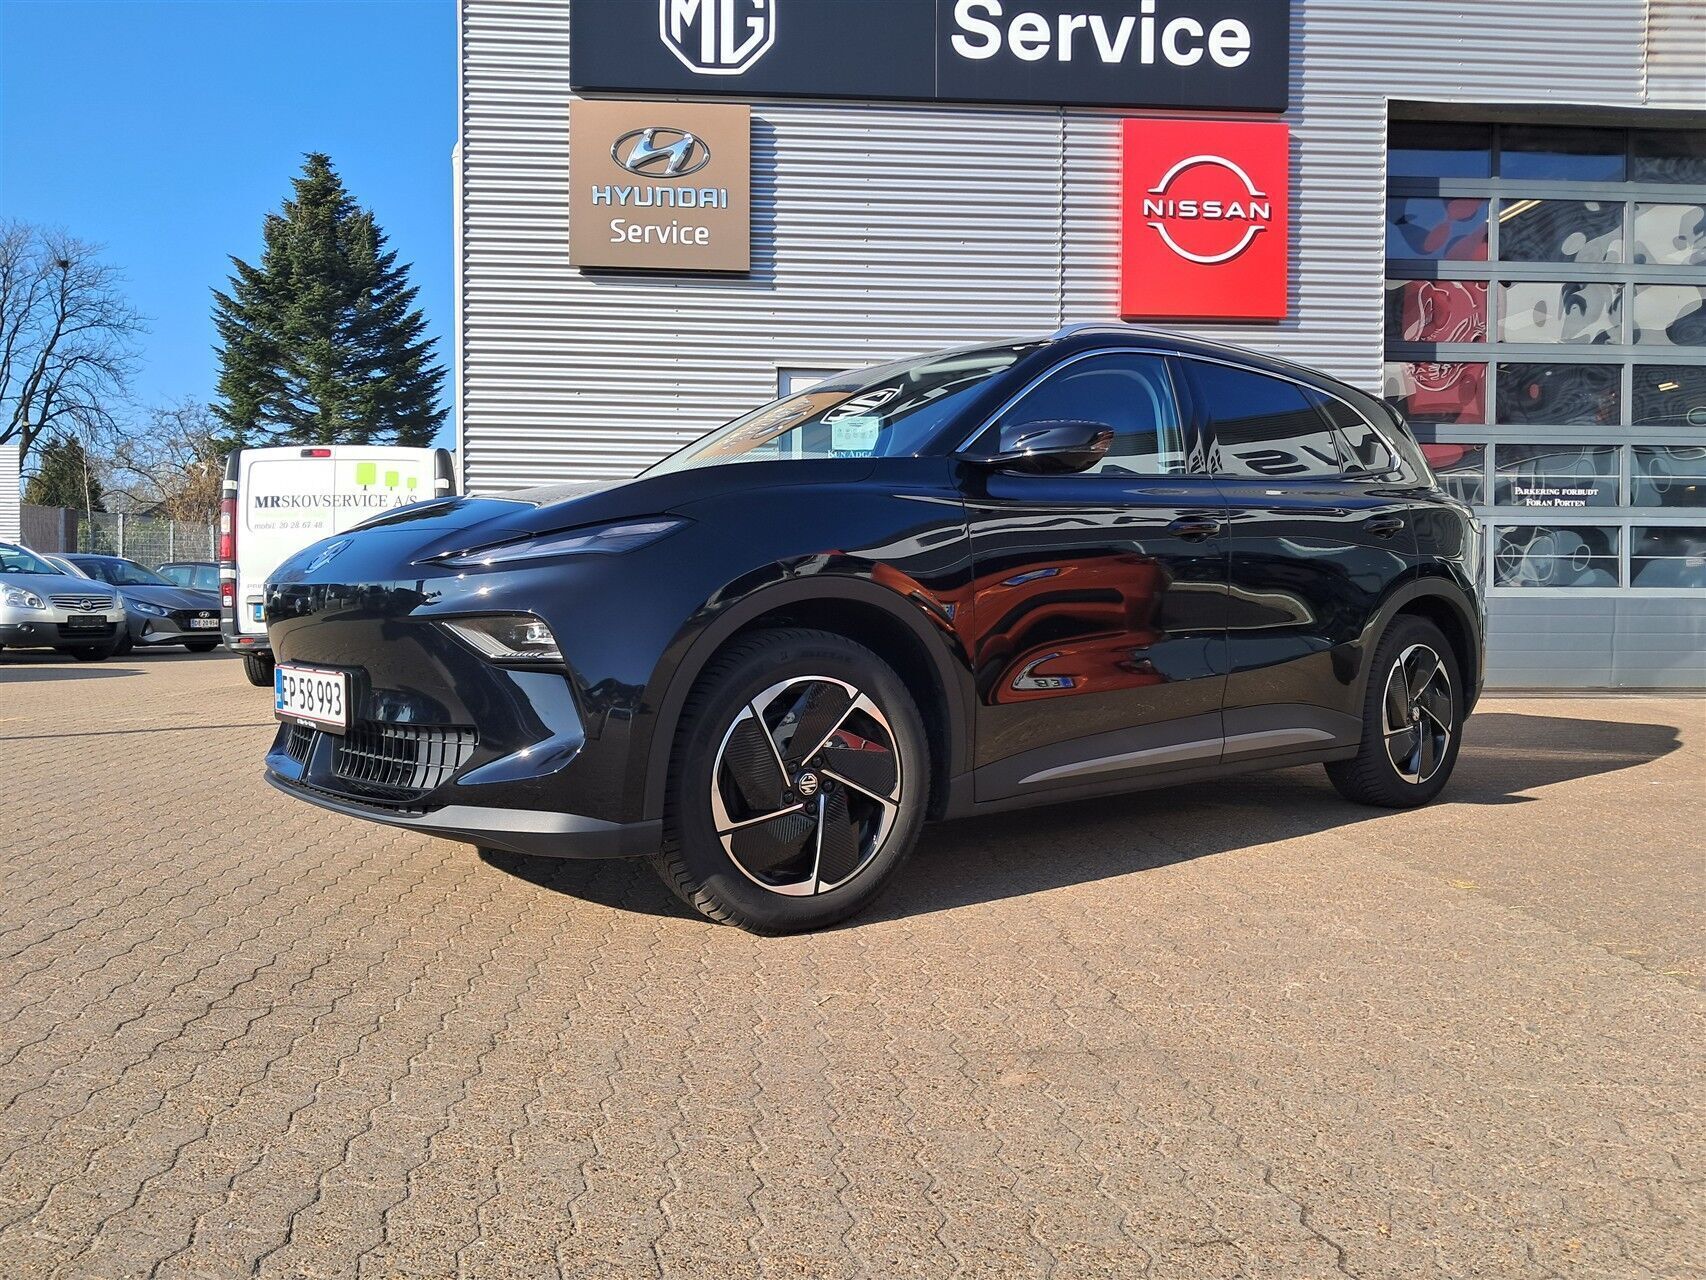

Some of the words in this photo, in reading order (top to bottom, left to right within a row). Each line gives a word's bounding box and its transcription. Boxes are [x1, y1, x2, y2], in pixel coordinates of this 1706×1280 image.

[671, 0, 765, 64] MG
[951, 0, 1251, 68] Service
[591, 185, 728, 209] HYUNDAI
[1143, 198, 1271, 220] NISSAN
[610, 218, 710, 246] Service
[254, 494, 388, 509] MRSKOVSERVICE
[393, 495, 418, 508] A/S
[290, 521, 301, 529] 28
[313, 521, 323, 529] 48
[282, 675, 296, 707] EP
[299, 677, 315, 712] 58
[317, 680, 342, 716] 993
